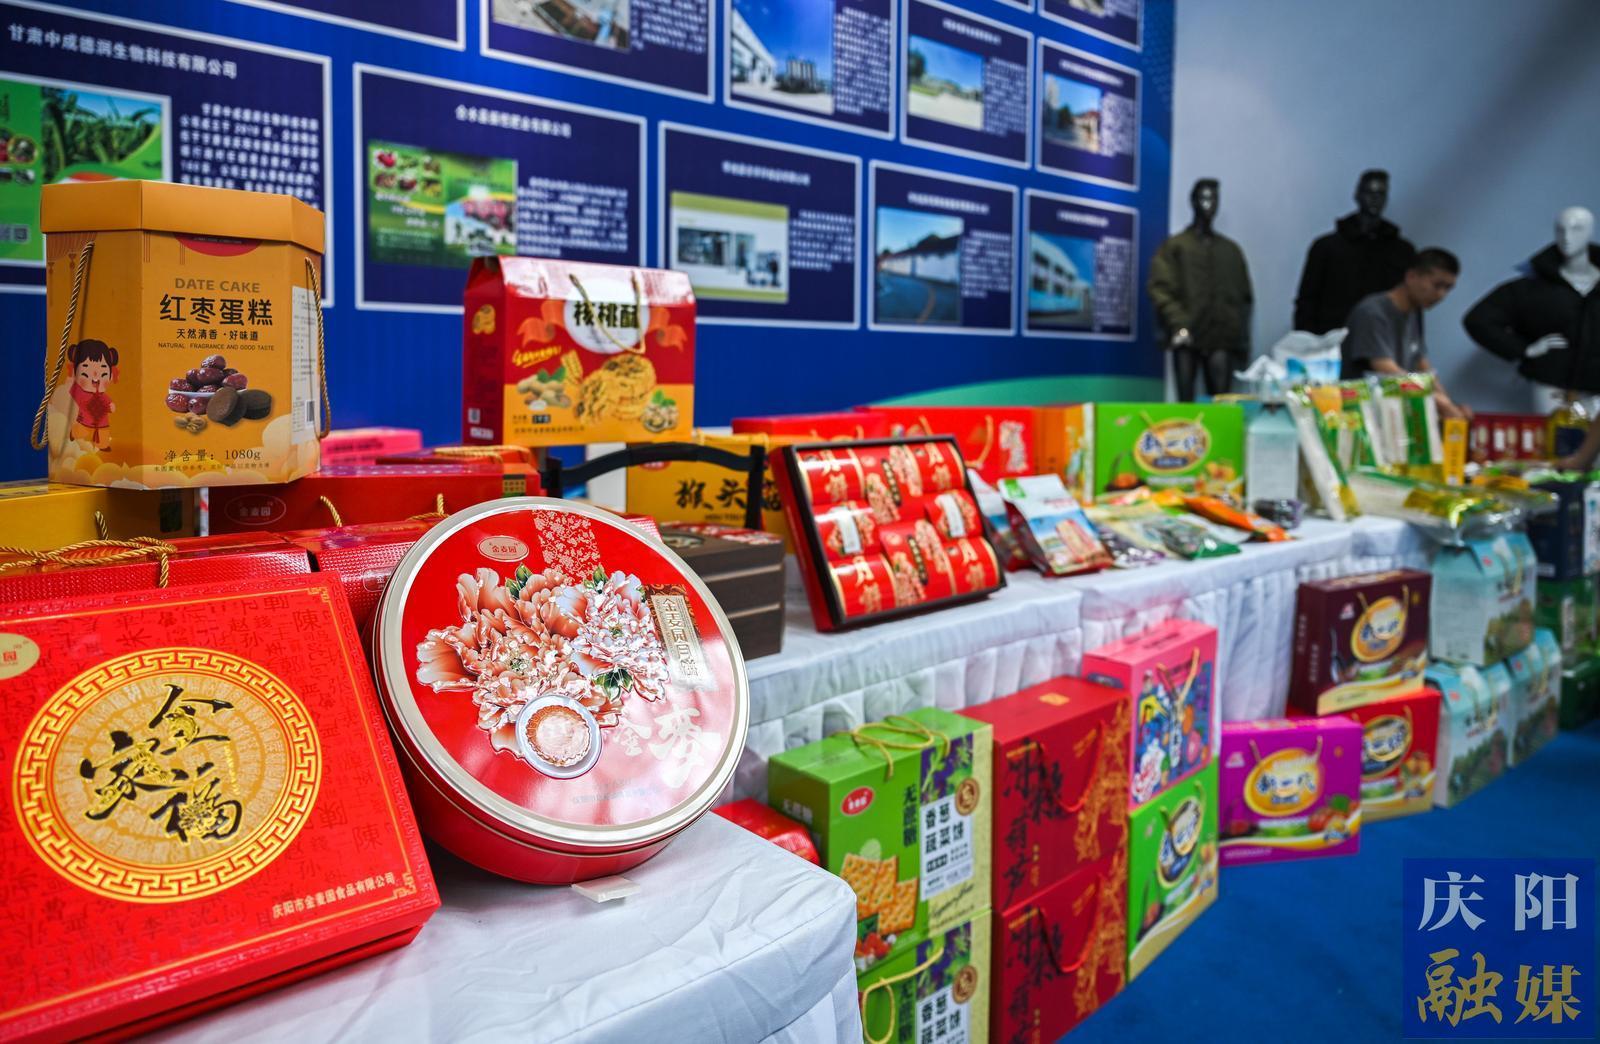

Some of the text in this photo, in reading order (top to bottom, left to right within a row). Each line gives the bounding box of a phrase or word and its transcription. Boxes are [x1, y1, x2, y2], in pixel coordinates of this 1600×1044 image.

[8, 23, 238, 79] 甘肃中成德润生物科技有限公司
[175, 278, 260, 293] DATE CAKE
[160, 294, 273, 326] 红枣蛋糕
[573, 300, 640, 329] 核桃酥
[225, 448, 261, 461] 1080g
[272, 872, 396, 919] 庆阳市金麦园食品有限公司
